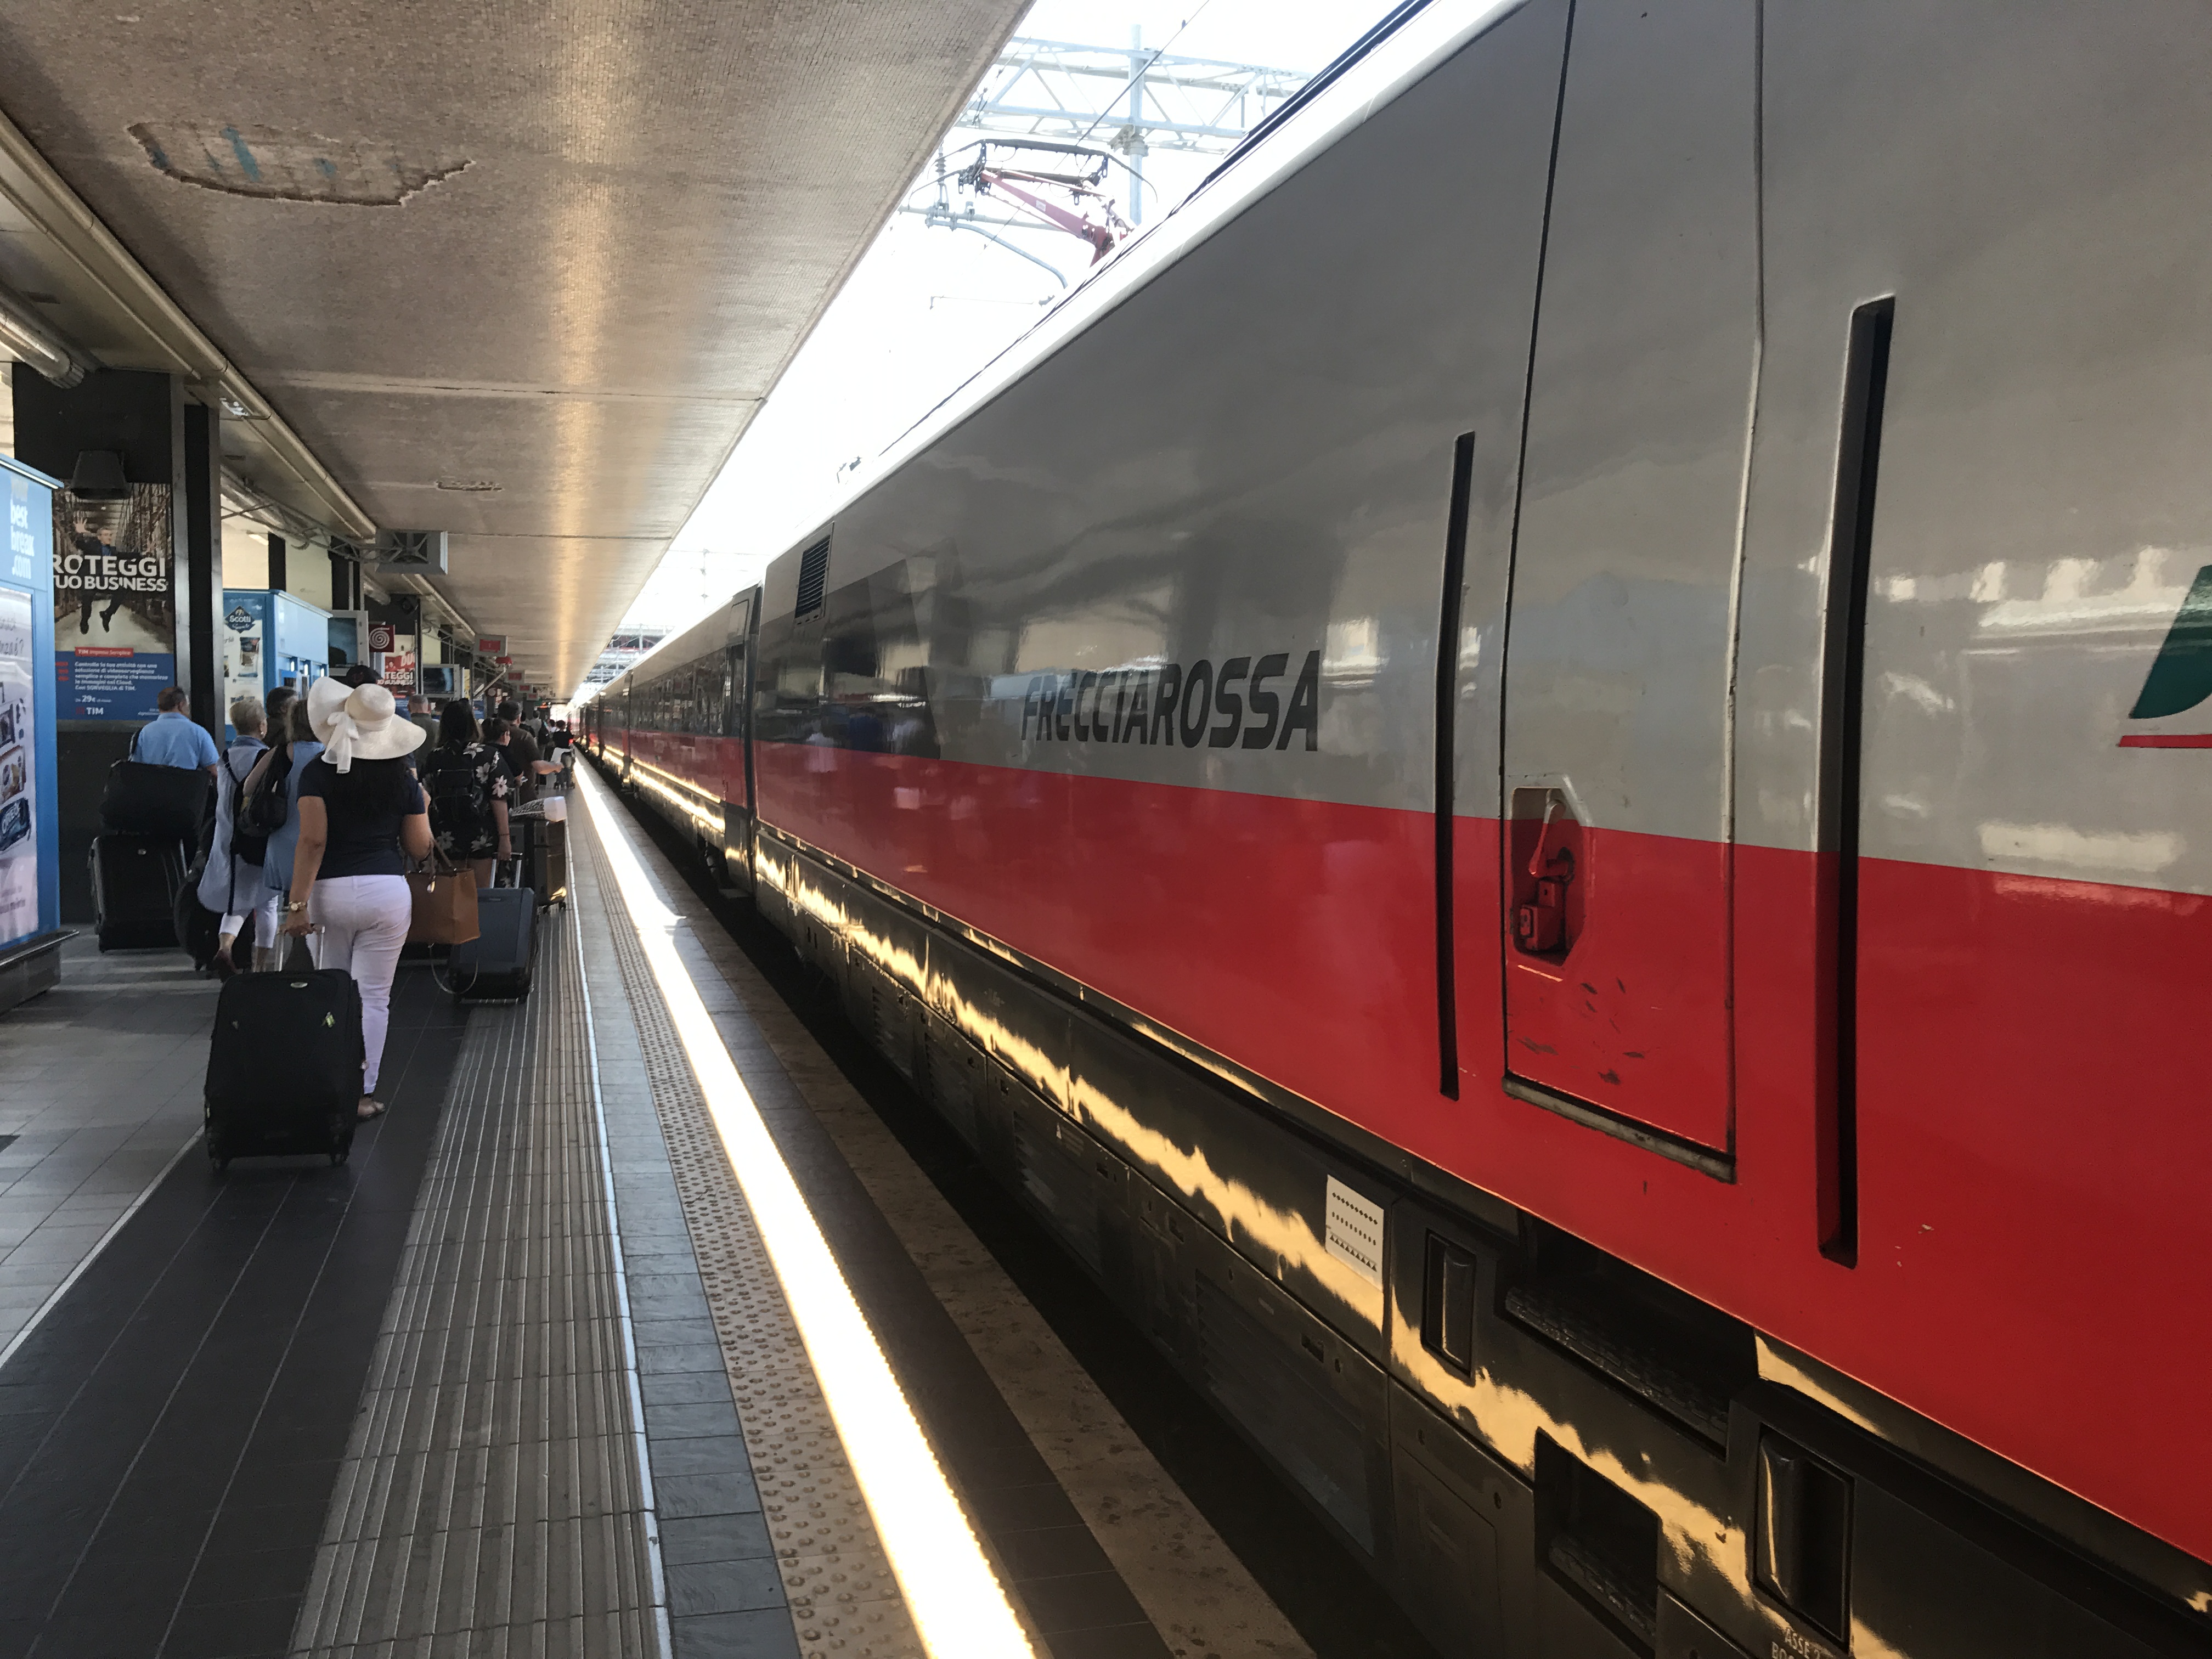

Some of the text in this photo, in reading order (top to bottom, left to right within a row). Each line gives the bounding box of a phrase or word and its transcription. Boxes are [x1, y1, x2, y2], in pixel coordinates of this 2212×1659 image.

[10, 498, 28, 529] best
[10, 524, 35, 557] break
[12, 555, 32, 580] .com
[84, 575, 167, 592] BUSINESS
[86, 707, 104, 715] TIM
[1021, 649, 1321, 752] FRECCIAROSSA
[1784, 1628, 1810, 1659] ASSE
